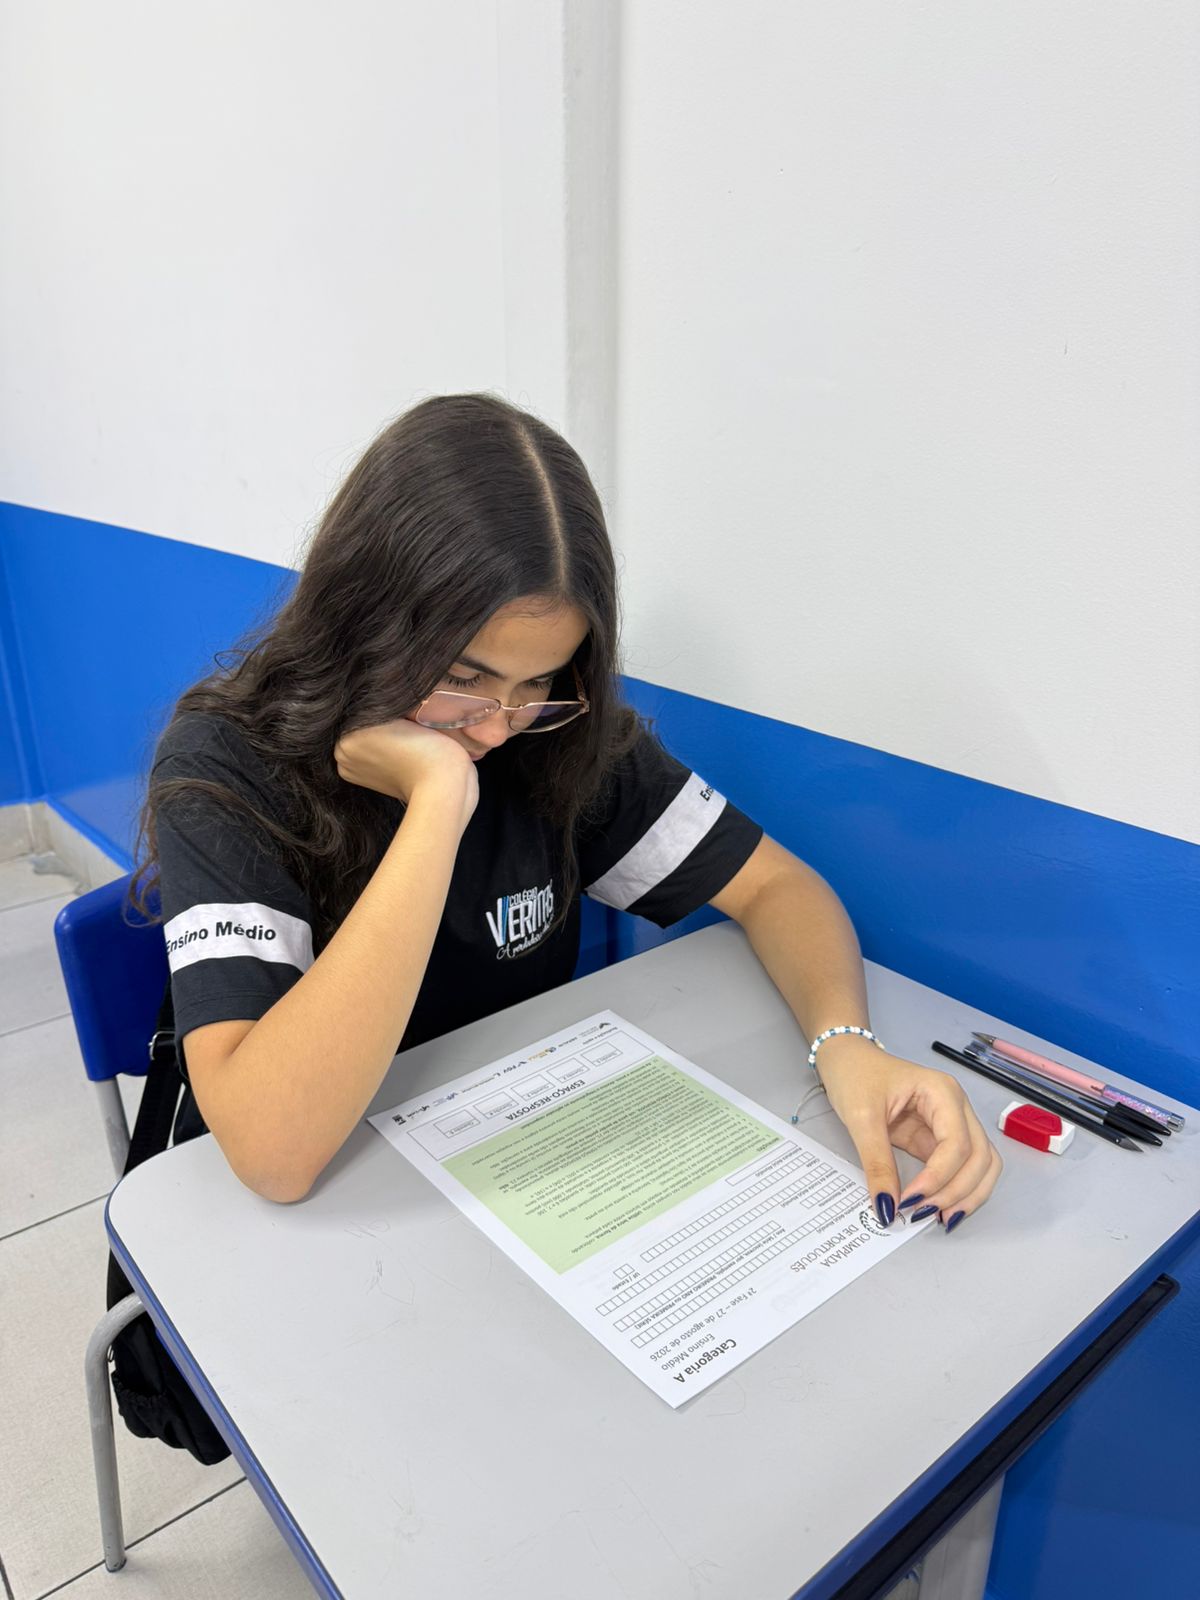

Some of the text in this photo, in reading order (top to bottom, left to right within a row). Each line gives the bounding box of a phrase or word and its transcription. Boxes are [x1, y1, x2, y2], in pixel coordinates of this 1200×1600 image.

[166, 921, 276, 954] Ensino Médio
[503, 1079, 587, 1121] ESPAÇO-RESPOSTA
[787, 1223, 860, 1273] DE PORTUGUÊS
[818, 1231, 874, 1270] OLIMPÍADA
[713, 1307, 727, 1317] 27
[728, 1292, 748, 1307] Fase
[677, 1320, 706, 1341] agosto
[703, 1314, 717, 1324] de
[648, 1344, 671, 1362] 2026
[659, 1332, 716, 1372] Ensino Médio
[668, 1337, 682, 1348] de
[672, 1336, 738, 1384] Categoria A
